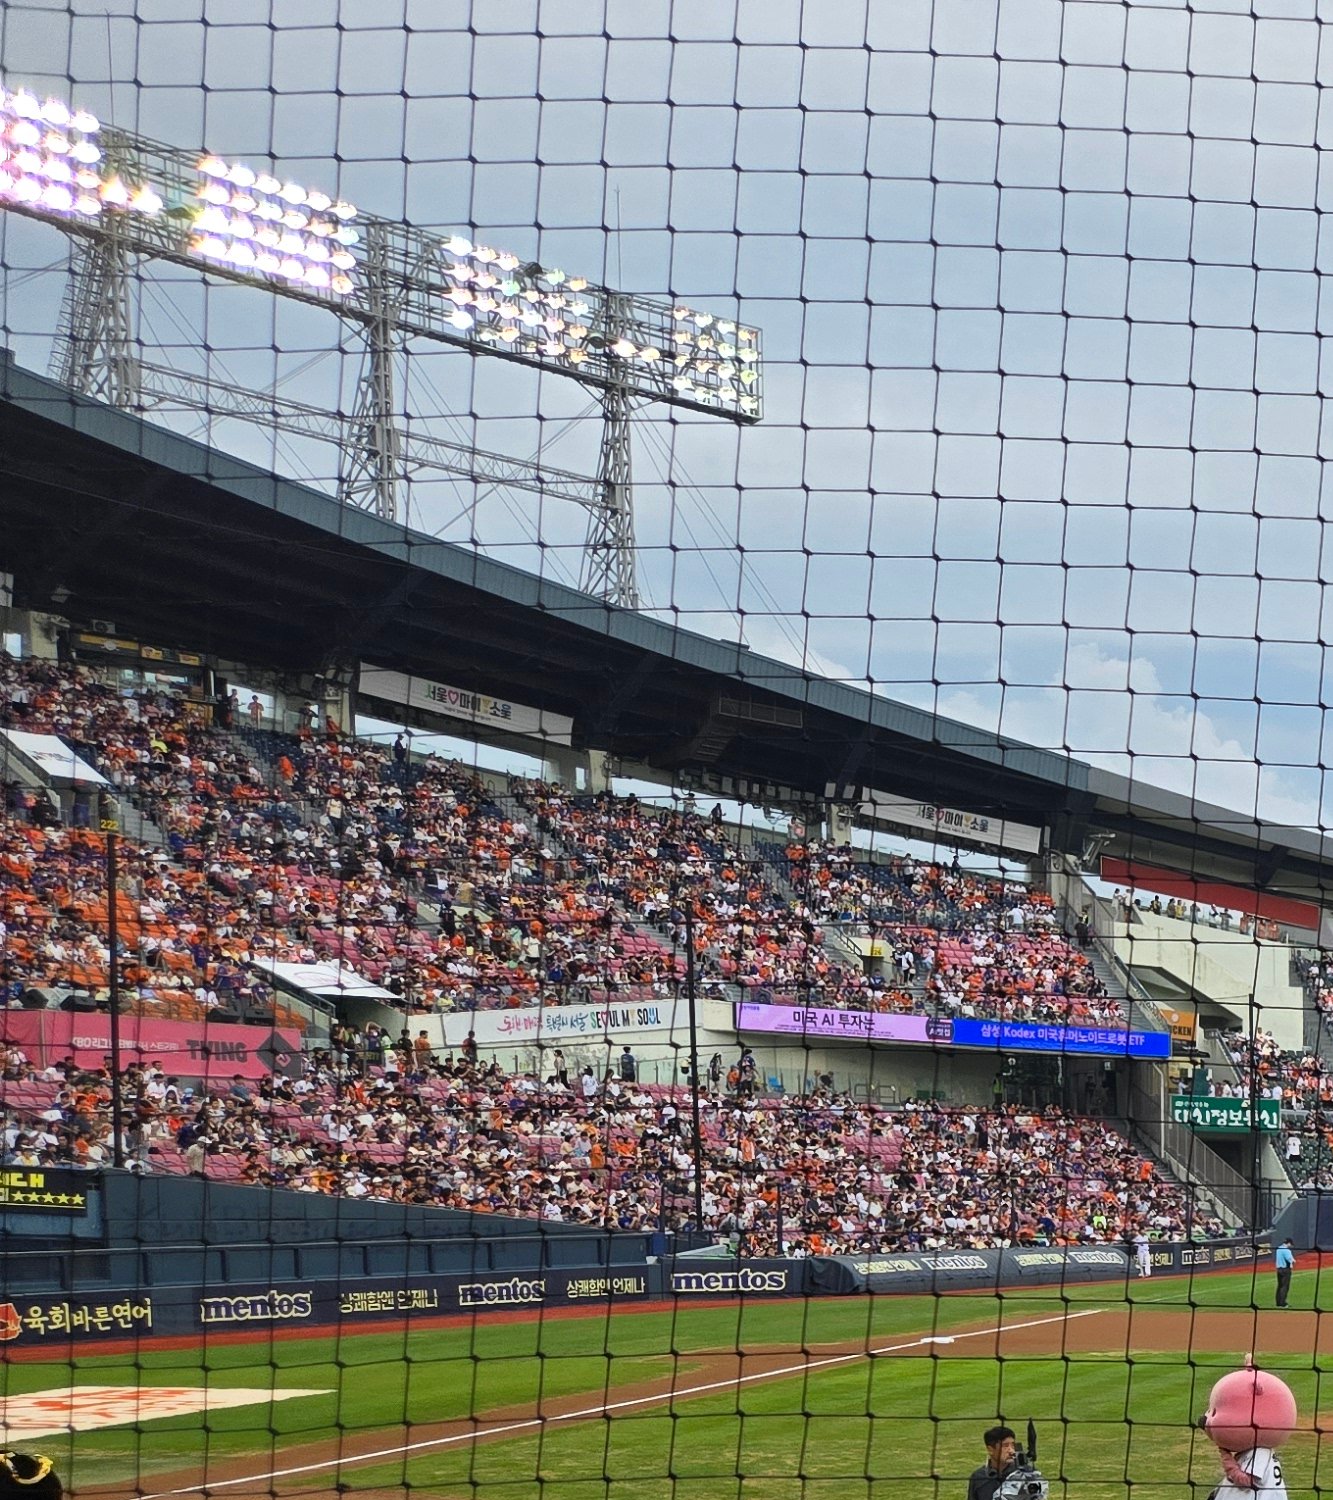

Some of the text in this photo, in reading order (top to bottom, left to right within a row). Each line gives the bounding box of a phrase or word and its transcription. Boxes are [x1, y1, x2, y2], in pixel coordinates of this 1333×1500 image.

[793, 1011, 818, 1027] 미국
[822, 1014, 835, 1026] AI
[838, 1014, 875, 1031] 투자는
[981, 1023, 1000, 1038] 삼성
[1003, 1026, 1035, 1039] Kodex
[459, 1277, 546, 1306] mentos
[673, 1268, 788, 1293] mentos
[23, 1299, 152, 1335] 육회바른연어
[201, 1290, 313, 1323] mentos
